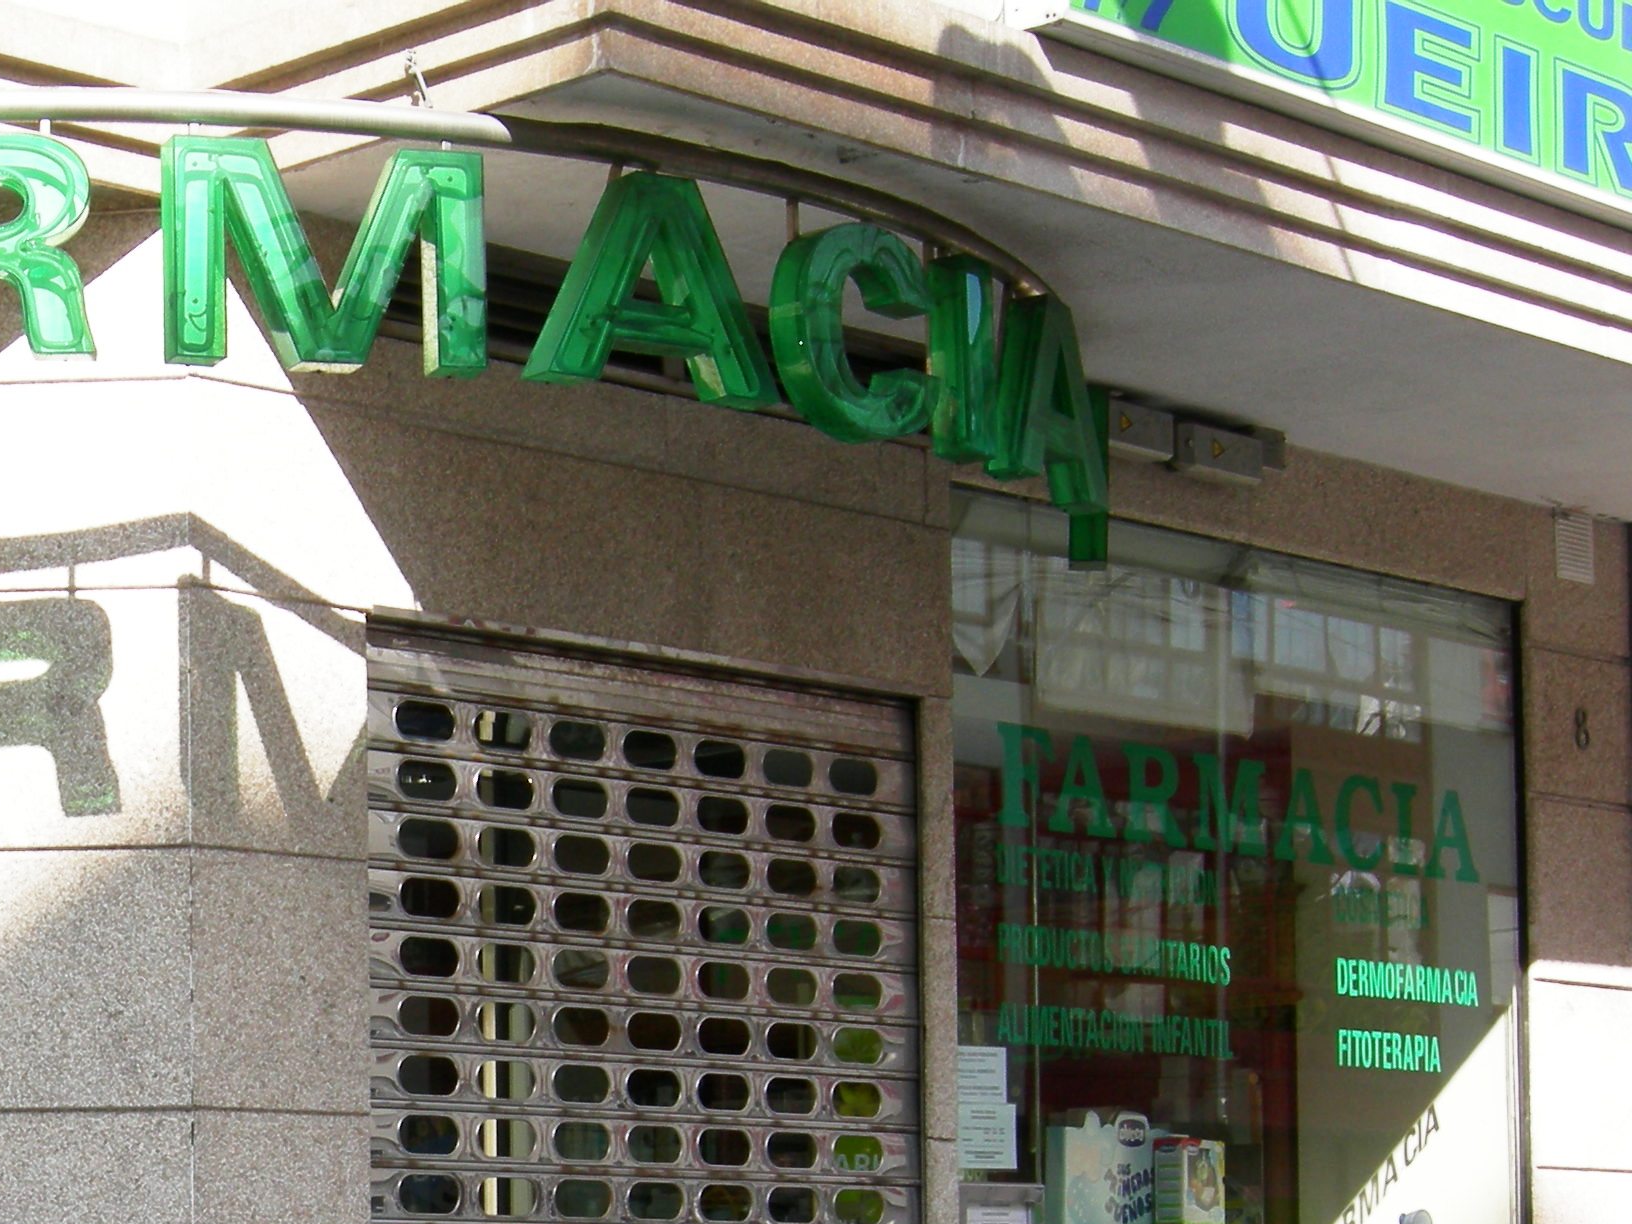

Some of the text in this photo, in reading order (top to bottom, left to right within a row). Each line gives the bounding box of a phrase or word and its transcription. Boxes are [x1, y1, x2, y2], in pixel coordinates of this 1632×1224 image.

[996, 720, 1481, 884] FARMACIA
[1336, 957, 1480, 1008] DERMOFARMACIA
[1338, 1028, 1443, 1073] FITOTERAPIA
